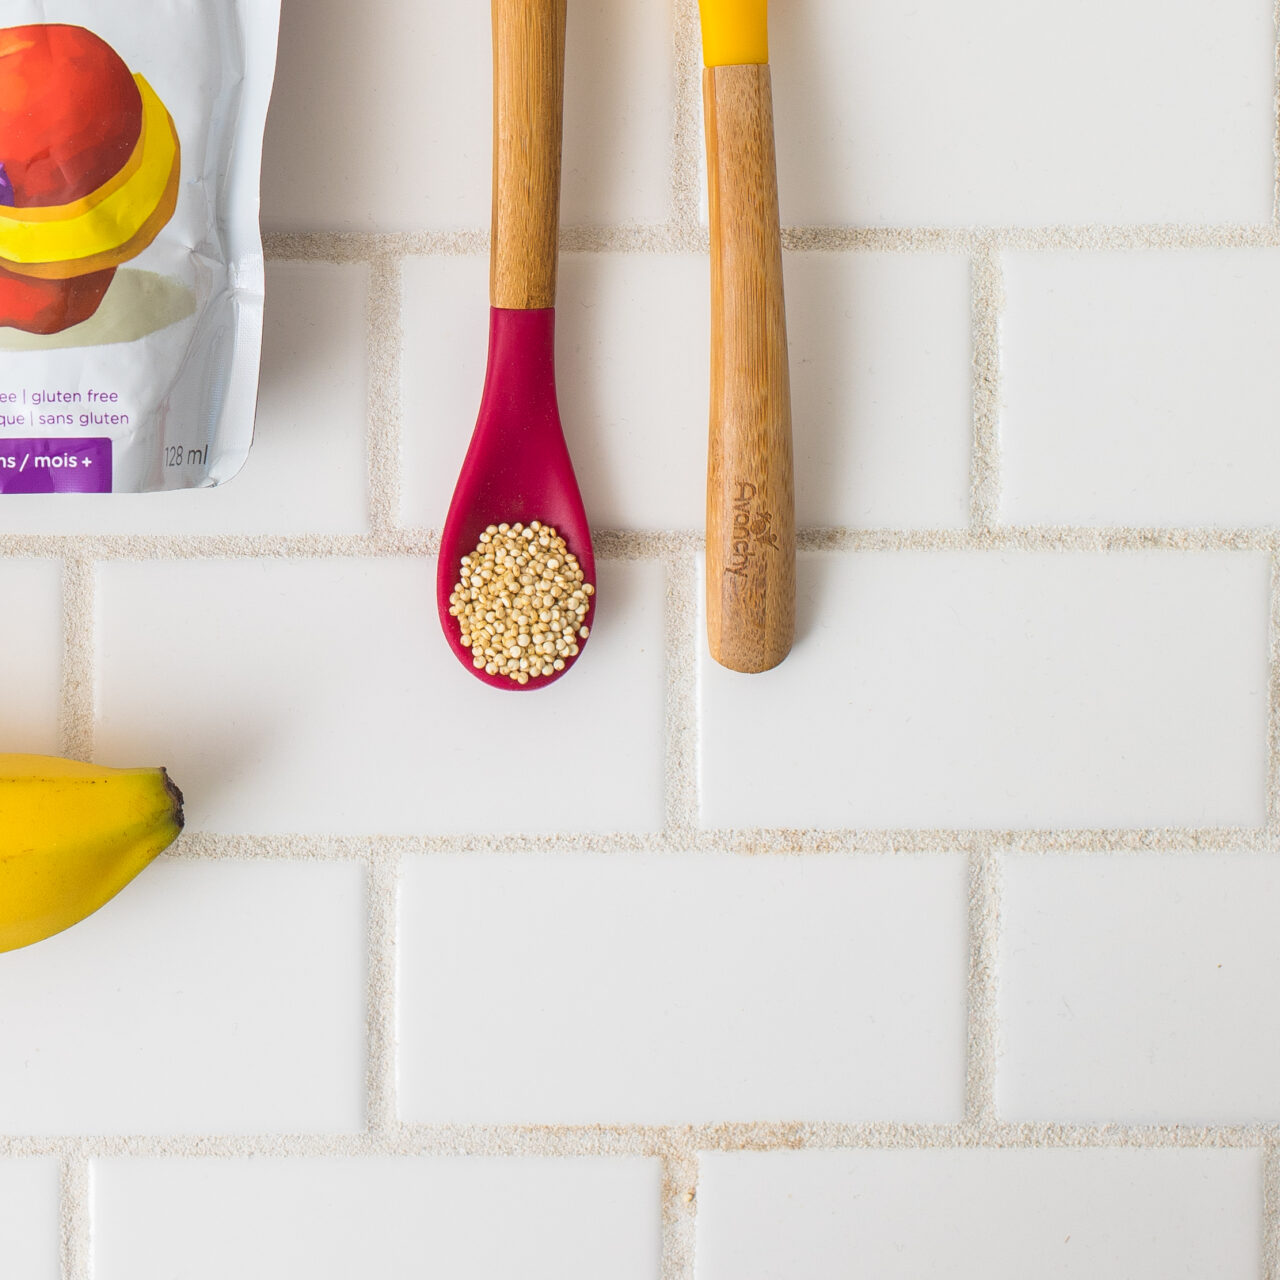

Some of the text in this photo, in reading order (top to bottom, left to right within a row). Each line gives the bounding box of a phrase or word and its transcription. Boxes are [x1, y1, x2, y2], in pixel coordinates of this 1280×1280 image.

[32, 389, 82, 406] gluten
[87, 389, 119, 403] free
[39, 414, 74, 425] sans
[79, 411, 129, 427] gluten
[34, 452, 78, 468] mois
[165, 444, 209, 467] 128 ml
[724, 479, 757, 578] Avanchy
